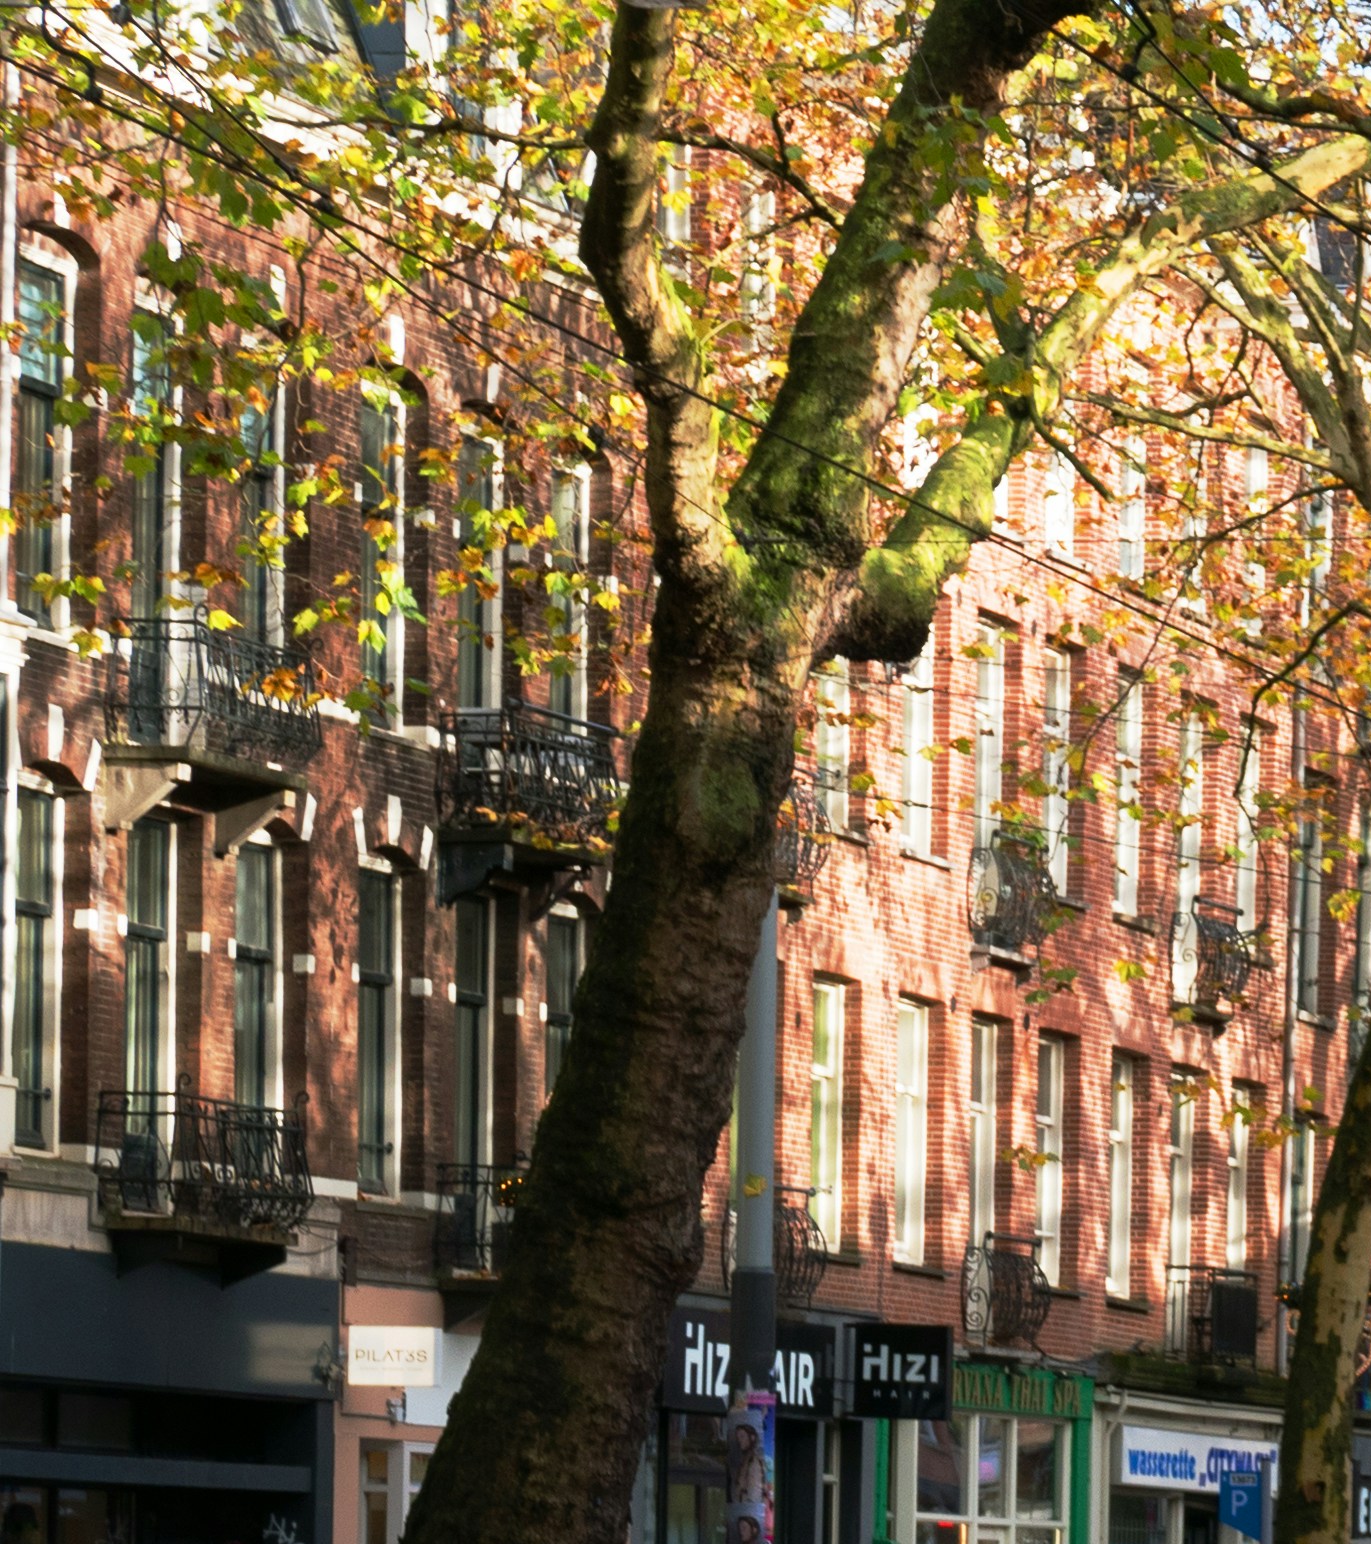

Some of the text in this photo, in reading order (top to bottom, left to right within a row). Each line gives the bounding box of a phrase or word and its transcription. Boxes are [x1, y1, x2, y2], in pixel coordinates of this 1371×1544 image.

[773, 1350, 815, 1407] AIR
[872, 1389, 931, 1400] HAIR
[1128, 1448, 1197, 1480] wasserette
[1231, 1490, 1248, 1517] P
